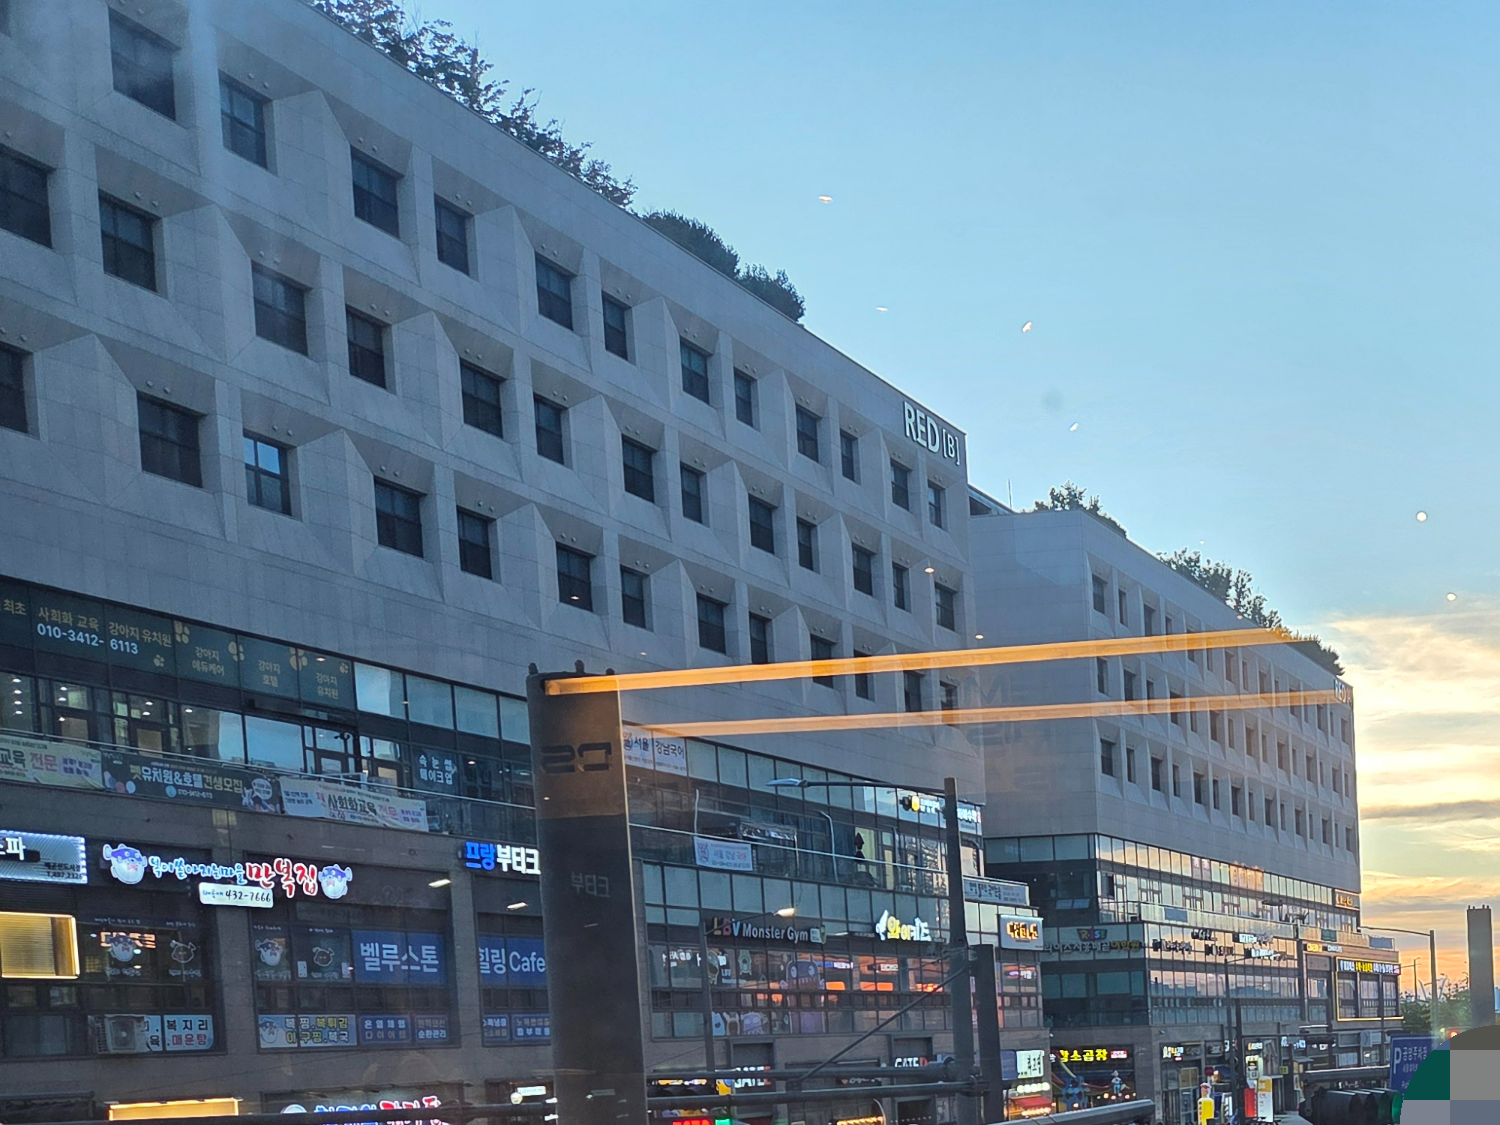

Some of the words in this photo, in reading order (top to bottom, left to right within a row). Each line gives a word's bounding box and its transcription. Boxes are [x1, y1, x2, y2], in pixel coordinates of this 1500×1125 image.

[904, 401, 940, 453] RED
[38, 606, 74, 626] 사회화
[77, 615, 100, 632] 교육
[108, 621, 140, 641] 강아지
[141, 629, 173, 648] 유치원
[195, 646, 220, 662] 강아지
[192, 660, 225, 677] 에듀케어
[258, 660, 281, 675] 강아지
[262, 674, 279, 688] 호텔
[316, 672, 338, 687] 강아지
[317, 687, 339, 700] 유치원
[634, 737, 650, 752] 서울
[655, 740, 685, 759] 강남국어
[30, 752, 58, 772] 전문
[246, 857, 318, 898] 만복집
[742, 923, 785, 940] Monster
[786, 925, 809, 945] Gym
[359, 942, 440, 974] 벨루스톤
[478, 947, 507, 976] 힐링
[508, 951, 546, 973] Cafe
[166, 1018, 209, 1032] 복지리
[1393, 1047, 1402, 1075] P
